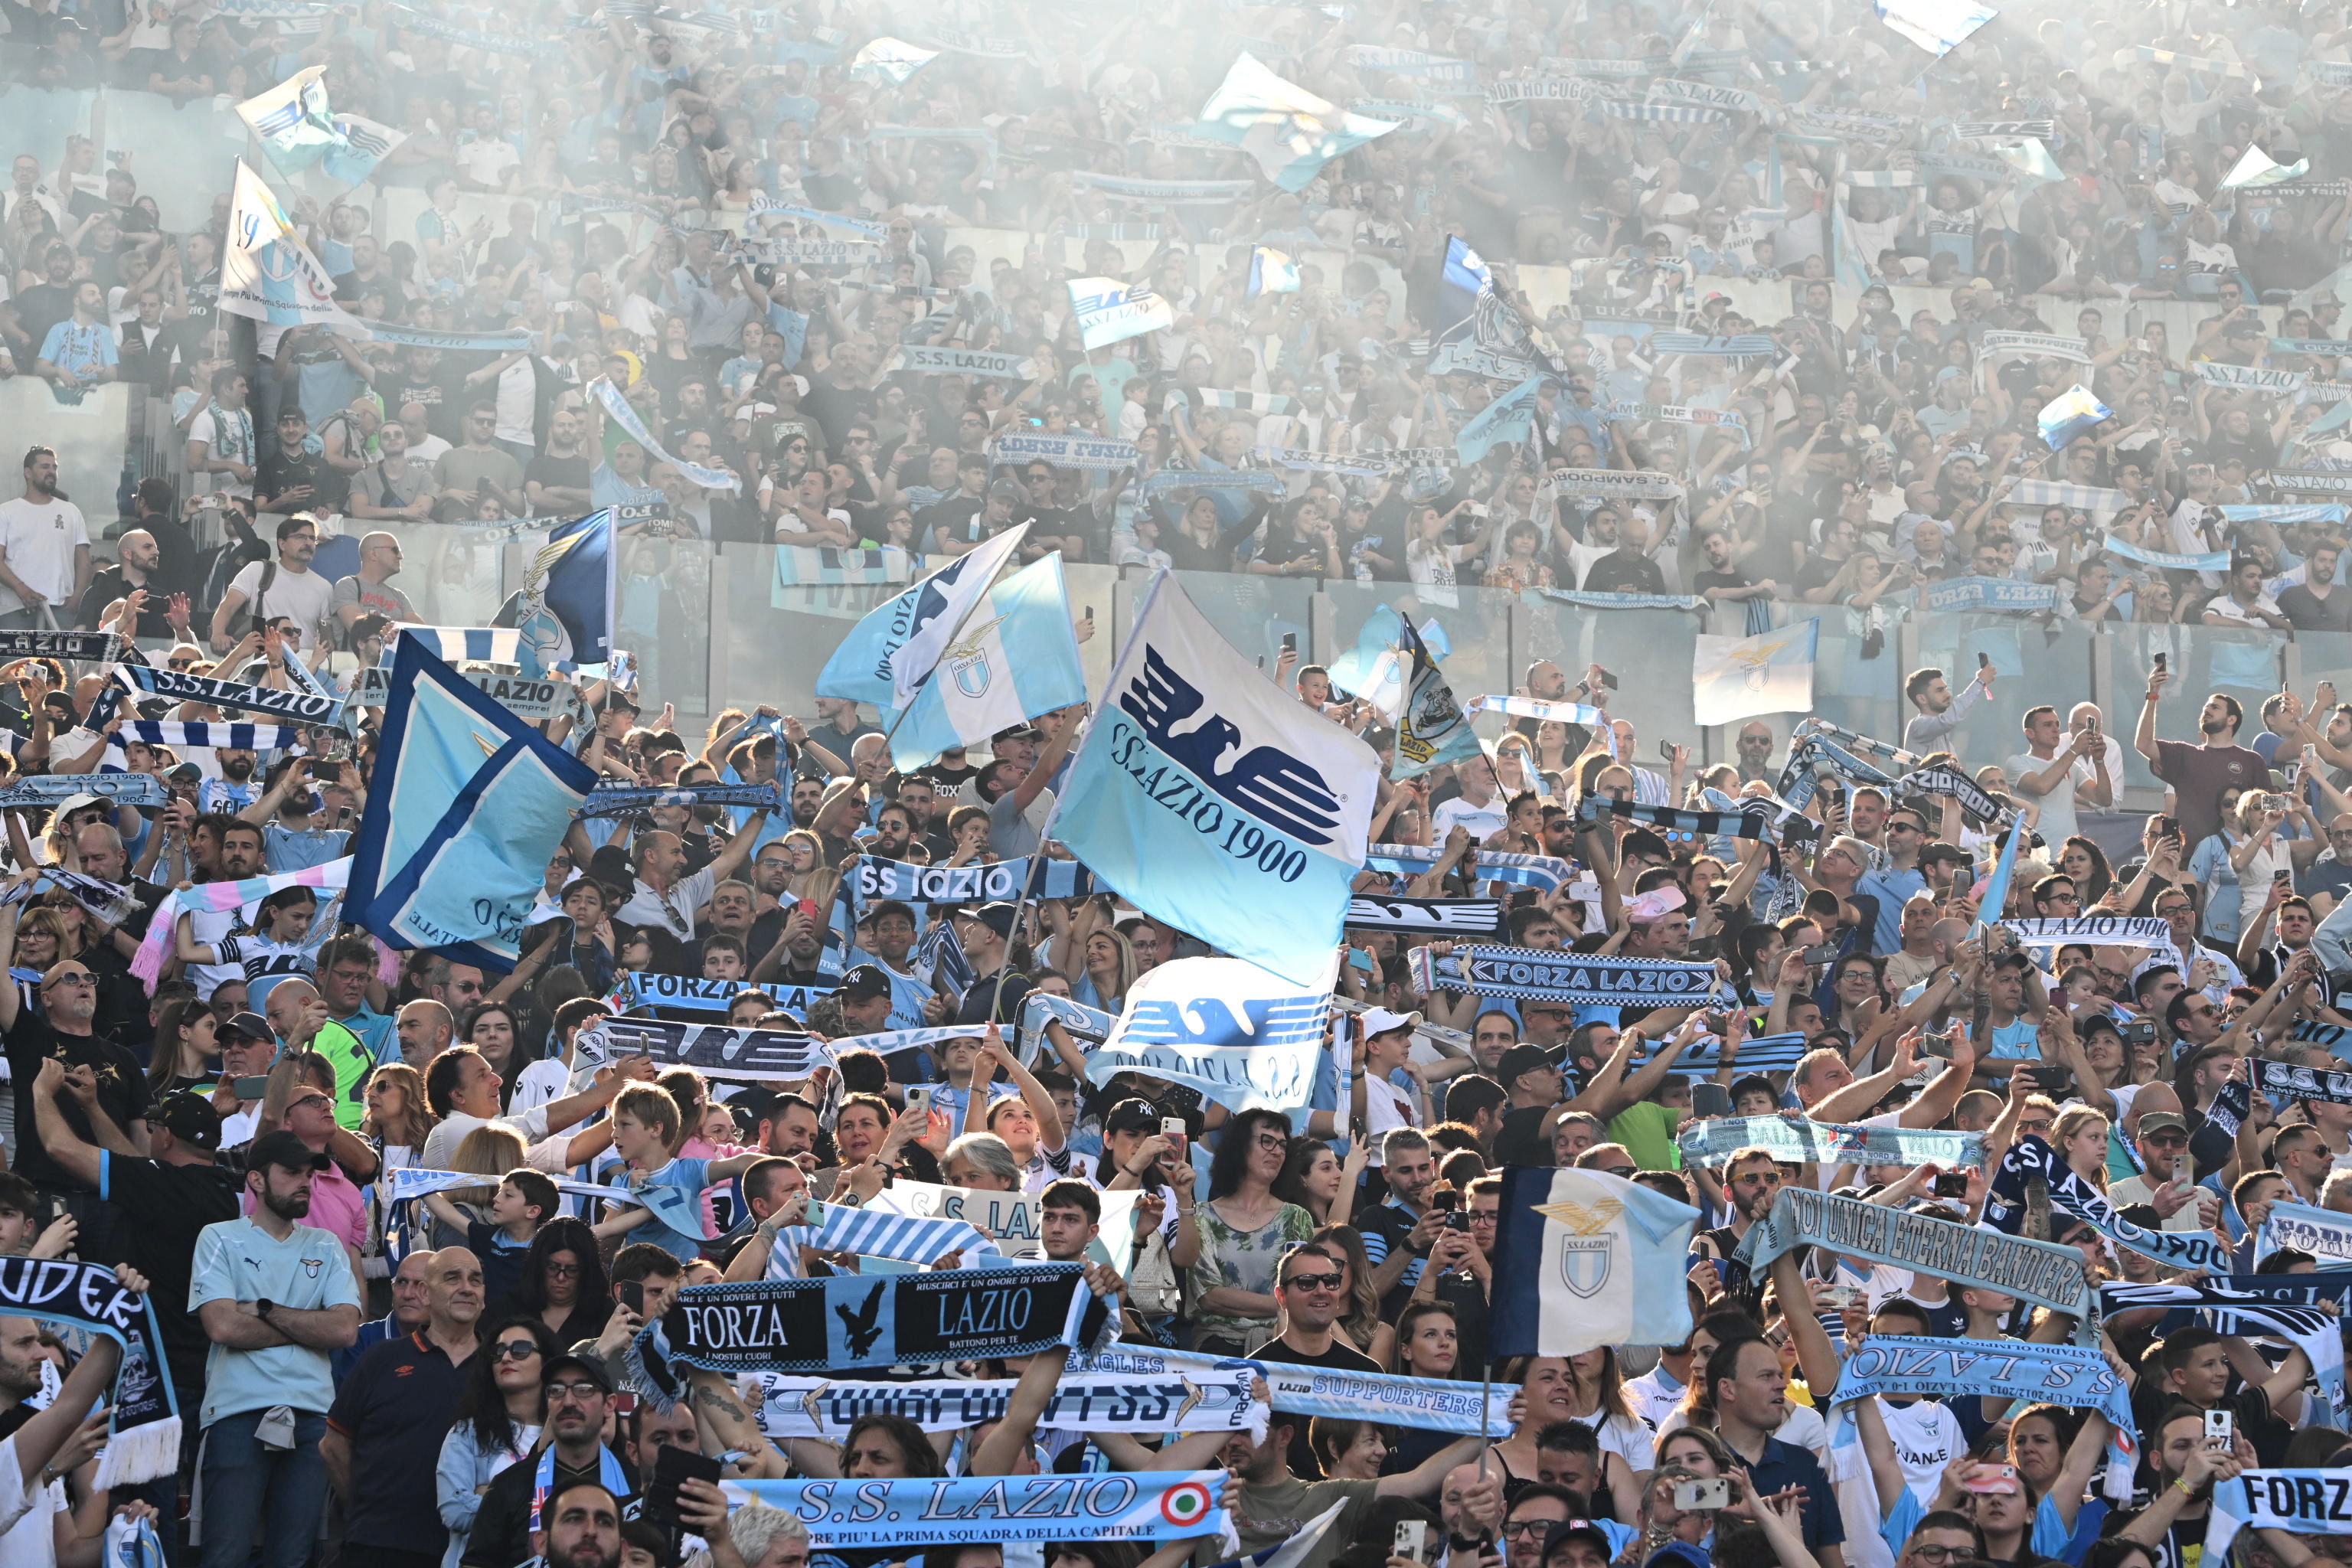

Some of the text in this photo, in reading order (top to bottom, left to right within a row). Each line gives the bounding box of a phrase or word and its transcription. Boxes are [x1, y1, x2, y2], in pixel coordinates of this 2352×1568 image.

[1489, 82, 1544, 101] NON HO
[2278, 188, 2305, 198] my
[801, 243, 846, 256] LAZIO
[914, 351, 1006, 371] S.S. LAZIO
[1382, 449, 1445, 462] S.S. LAZIO
[2280, 474, 2346, 491] SS LAZIO
[479, 677, 555, 704] LAZIO
[506, 702, 550, 713] sempre!
[1219, 818, 1307, 883] 1900
[911, 865, 1013, 900] lazio
[2121, 916, 2168, 939] 1900
[1494, 962, 1690, 991] FORZA LAZIO
[639, 973, 740, 1001] FORZA
[589, 1034, 603, 1048] LAZIO
[2264, 1063, 2323, 1093] S.S.
[1868, 1152, 1890, 1160] NORD
[1788, 1191, 2085, 1308] NOI UNICA ETERNA BANDIERA
[916, 1280, 959, 1291] RIUSCIRCI
[971, 1279, 985, 1288] UN
[987, 1276, 1018, 1286] ONORE
[1020, 1276, 1030, 1284] DI
[1032, 1274, 1061, 1283] POCHI
[707, 1290, 795, 1302] UN DOVERE DI TUTTI
[937, 1286, 1032, 1336] LAZIO
[682, 1303, 789, 1350] FORZA
[949, 1335, 1018, 1348] BATTONO PER TE
[712, 1352, 742, 1361] NOSTRI
[744, 1351, 771, 1361] CUORI
[2036, 1346, 2087, 1359] STADIO
[1063, 1352, 1165, 1375] EAGLES
[1851, 1347, 2025, 1381] LAZIO
[1891, 1380, 1907, 1391] 1-0
[1916, 1381, 1957, 1392] LAZIO
[1990, 1386, 2050, 1400] 2012/2013
[1229, 1371, 1252, 1427] macron
[1278, 1375, 1483, 1418] LAZIO SUPPORTERS
[2050, 1393, 2075, 1405] CUP
[2076, 1396, 2099, 1406] TIM
[795, 1476, 1137, 1524] S.S. LAZIO
[2239, 1475, 2351, 1521] FORZ
[838, 1524, 1155, 1543] PIU' LA PRIMA SQUADRA DELLA CAPITALE
